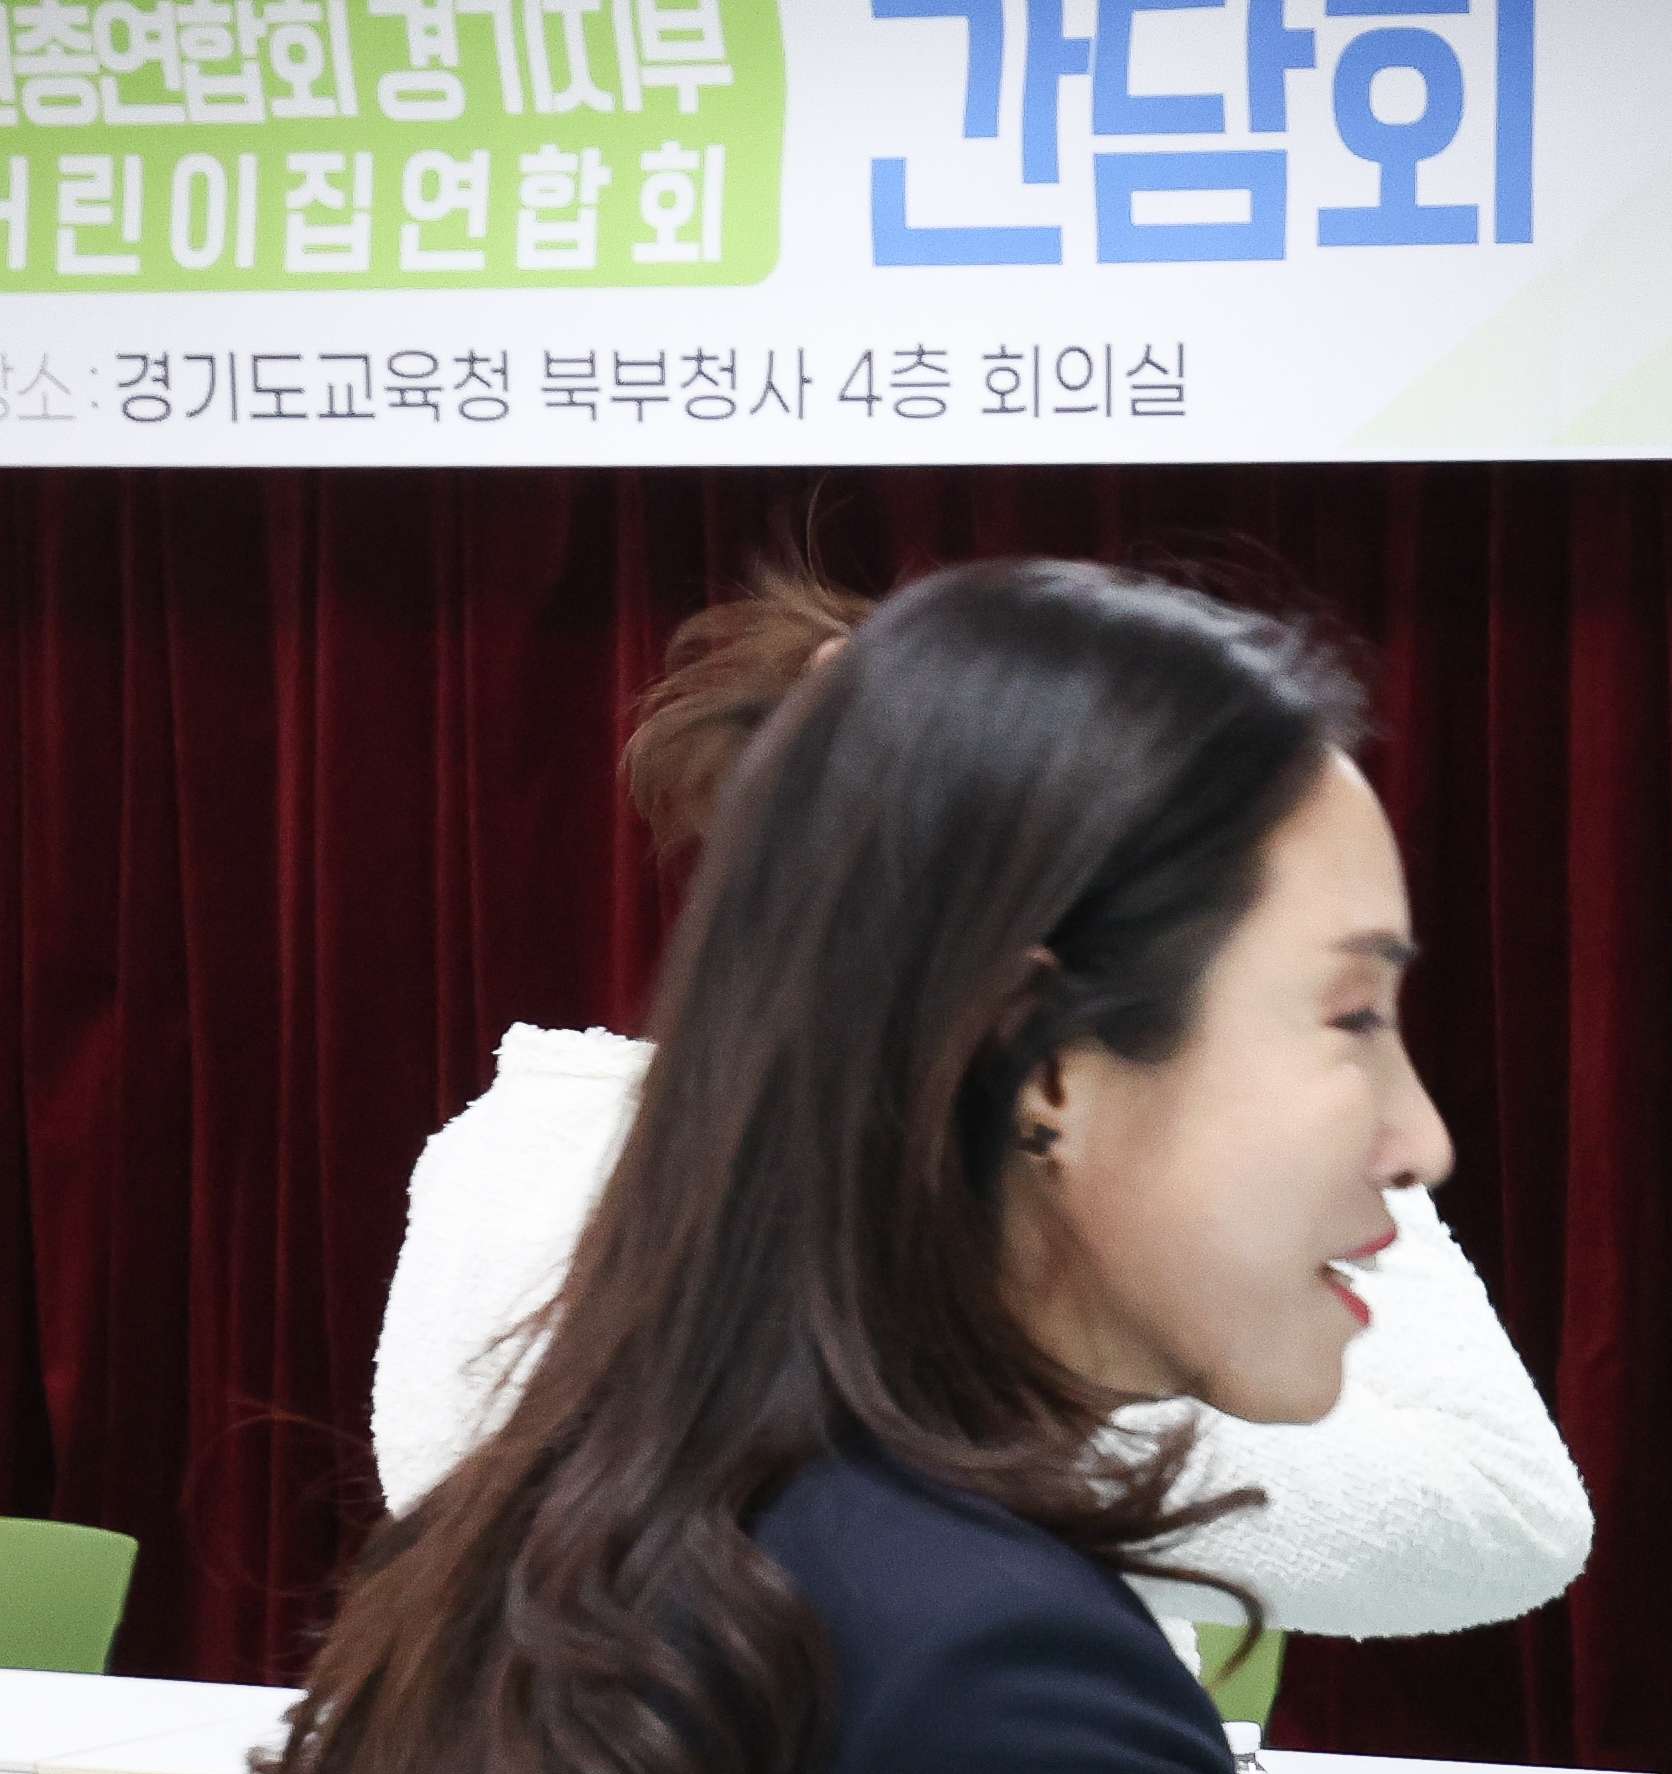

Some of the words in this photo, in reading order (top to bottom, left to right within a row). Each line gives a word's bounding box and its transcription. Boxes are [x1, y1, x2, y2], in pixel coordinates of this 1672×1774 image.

[0, 0, 360, 127] 총연합회
[366, 0, 735, 121] 경기지부
[870, 0, 1536, 267] 간담회
[114, 347, 511, 424] 경기도교육청
[540, 346, 813, 423] 북부청사
[838, 343, 952, 420] 4층
[980, 343, 1188, 418] 회의실
